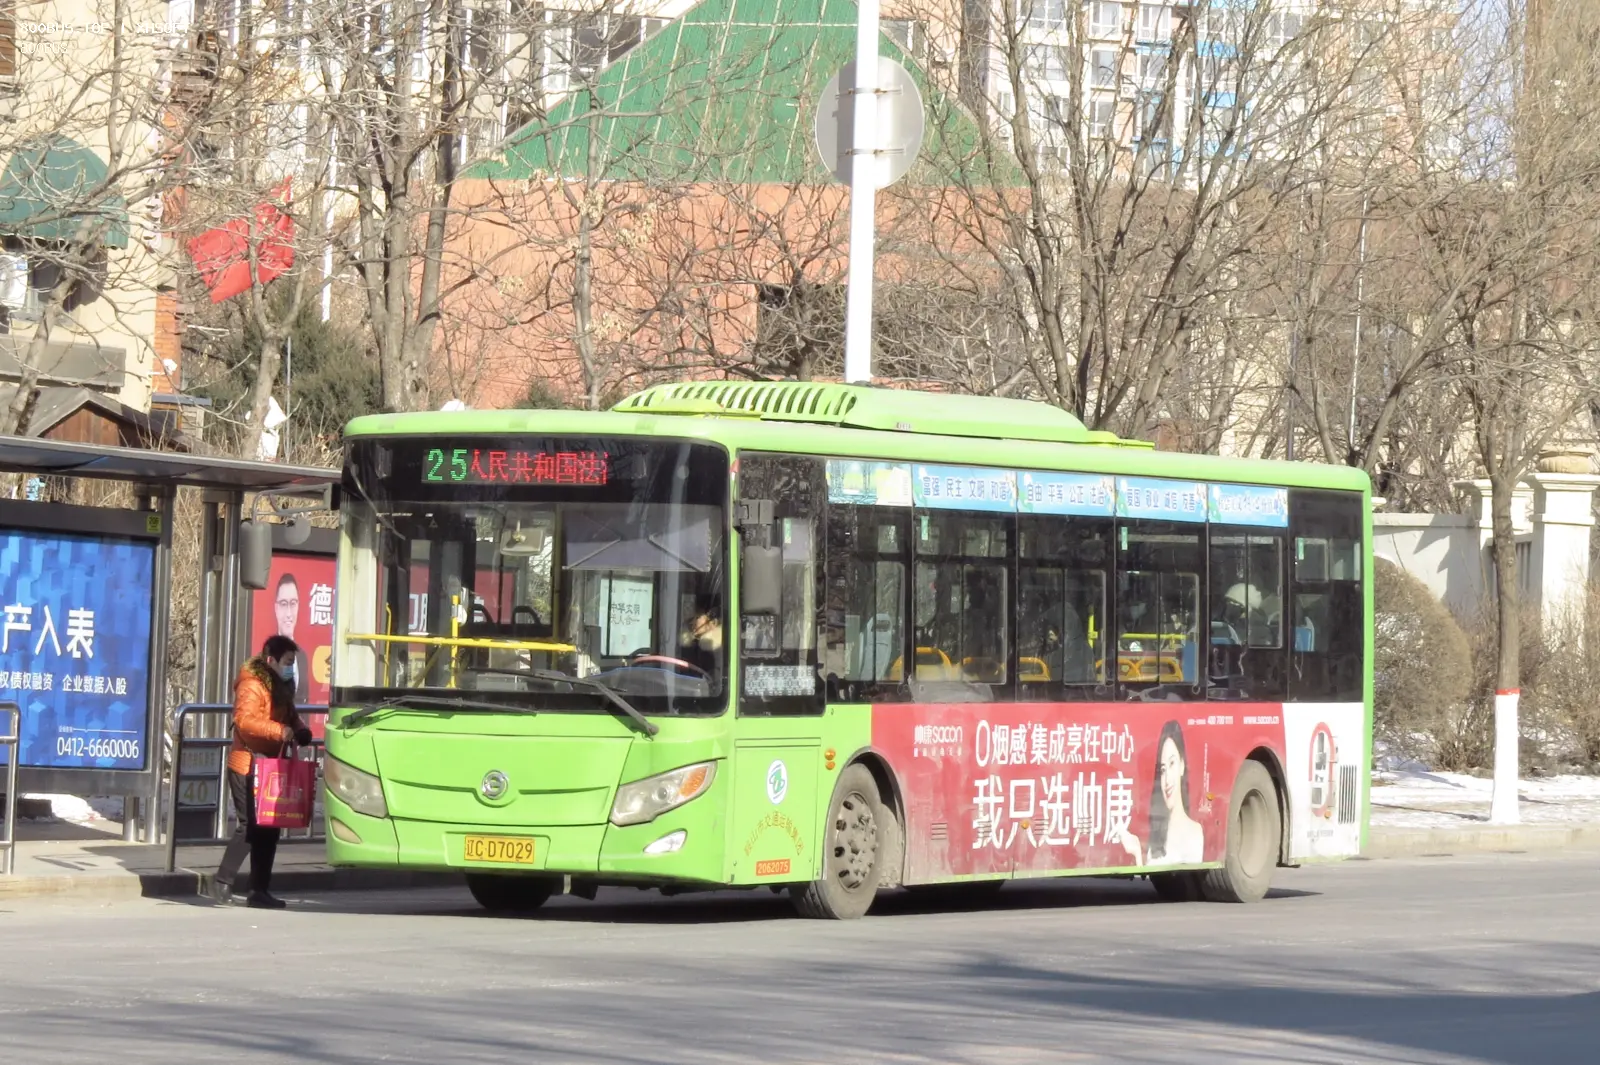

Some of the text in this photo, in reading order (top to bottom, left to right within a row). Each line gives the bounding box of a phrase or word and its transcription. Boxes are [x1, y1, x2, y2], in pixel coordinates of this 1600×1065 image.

[427, 449, 468, 481] 25
[945, 477, 963, 498] 民主
[968, 479, 985, 499] 文明
[1026, 483, 1043, 503] 自由
[1069, 485, 1084, 505] 公正
[2, 602, 95, 659] 产入表
[62, 674, 127, 695] 企业数据入股
[57, 736, 140, 759] 0412-6660006
[972, 771, 1134, 850] 我只选帅康
[757, 861, 790, 875] 2062075
